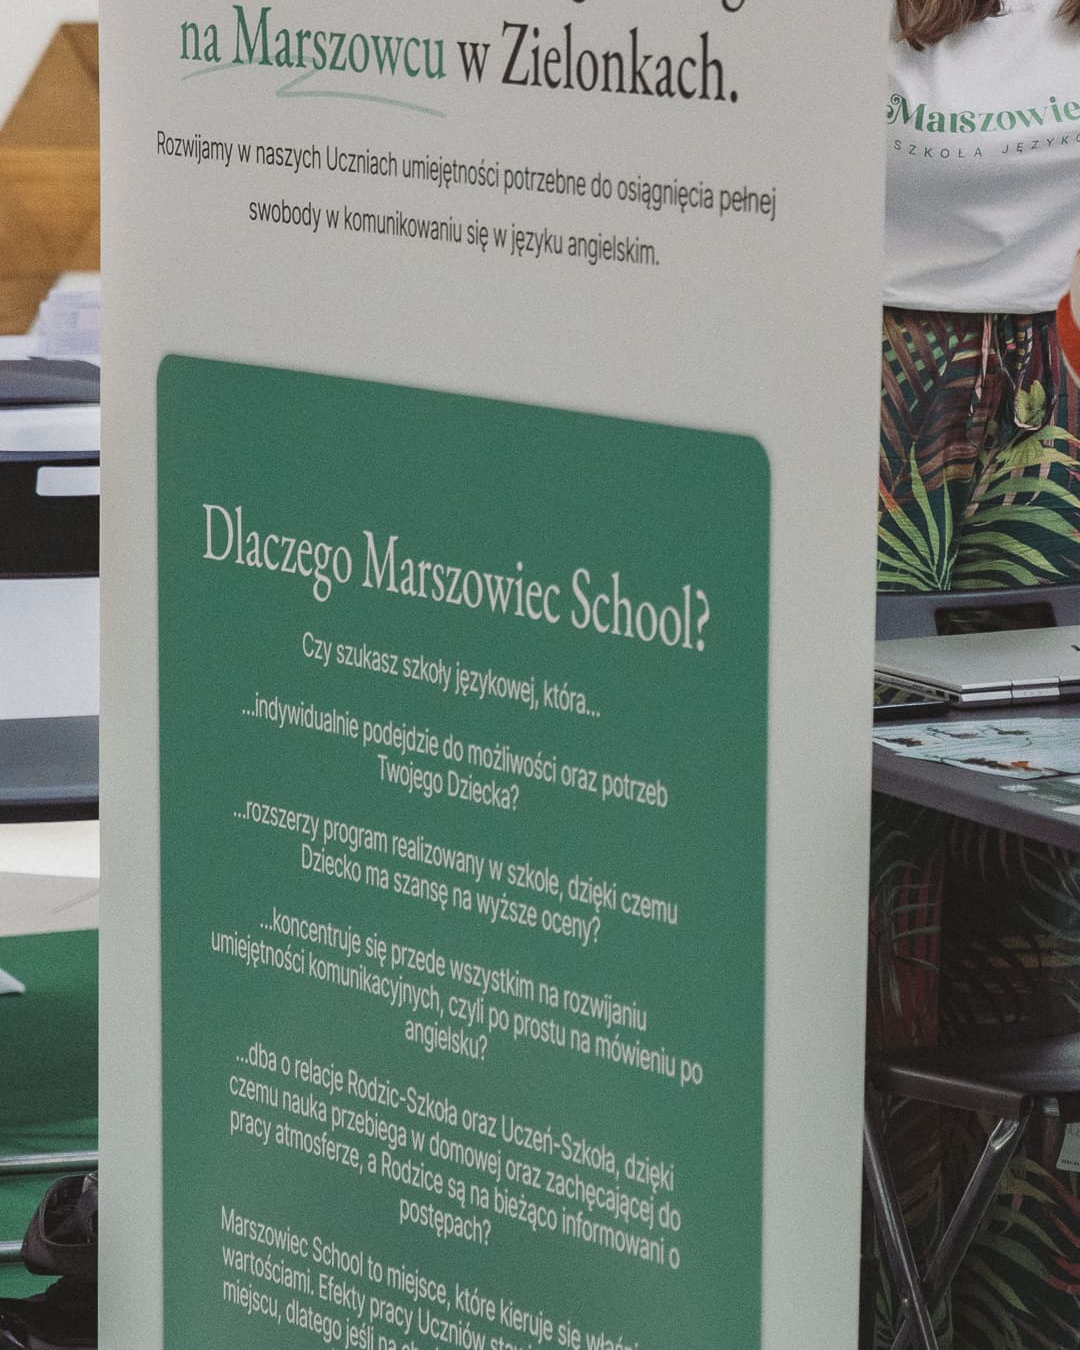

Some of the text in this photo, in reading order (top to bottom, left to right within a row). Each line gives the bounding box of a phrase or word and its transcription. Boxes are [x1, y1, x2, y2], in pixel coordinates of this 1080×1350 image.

[180, 3, 739, 103] na Marszowcu w Zielonkach.
[157, 130, 775, 221] Rozwijamy w naszych Uczniach umiejętności potrzebne do osiągnięcia pełnej
[249, 199, 659, 265] swobody w komunikowaniu się w języku angielskim.
[203, 504, 709, 651] Dlaczego Marszowiec School?
[303, 631, 332, 666] Czy
[337, 643, 398, 674] szukasz
[403, 655, 451, 691] szkoły
[455, 662, 538, 709] językowej,
[363, 721, 438, 755] podejdzie
[443, 734, 463, 761] do
[468, 743, 556, 782] możliwości
[561, 764, 597, 791] oraz
[602, 773, 668, 807] potrzeb
[378, 753, 519, 810] Twojego Dziecka?
[302, 843, 600, 946] Dziecko ma szansę na wyższe oceny?
[324, 819, 387, 852] program
[392, 835, 484, 882] realizowany
[489, 859, 503, 880] w
[508, 862, 563, 901] szkole,
[568, 874, 616, 912] dzięki
[621, 892, 677, 924] czemu
[212, 931, 703, 1086] umiejętności komunikacyjnych, czyli po prostu na mówieniu po
[366, 936, 387, 967] się
[391, 943, 445, 976] przede
[450, 959, 534, 1000] wszystkim
[539, 983, 558, 1007] na
[564, 990, 646, 1030] rozwijaniu
[405, 1019, 487, 1060] angielsku?
[230, 1075, 681, 1231] czemu nauka przebiega w domowej oraz zachęcającej do
[281, 1055, 290, 1075] o
[295, 1057, 343, 1094] relacje
[462, 1109, 496, 1137] oraz
[625, 1153, 674, 1193] dzięki
[230, 1110, 680, 1269] pracy atmosferze, a Rodzice są na bieżąco informowani o
[400, 1198, 491, 1245] postępach?
[221, 1205, 308, 1257] Marszowiec
[313, 1236, 363, 1275] School
[368, 1255, 383, 1282] to
[387, 1265, 451, 1311] miejsce,
[456, 1283, 495, 1321] które
[500, 1298, 553, 1341] kieruje
[222, 1246, 314, 1295] wartościami.
[319, 1273, 367, 1318] Efekty
[370, 1297, 413, 1335] pracy
[223, 1280, 281, 1323] miejscu,
[286, 1301, 342, 1343] dlatego
